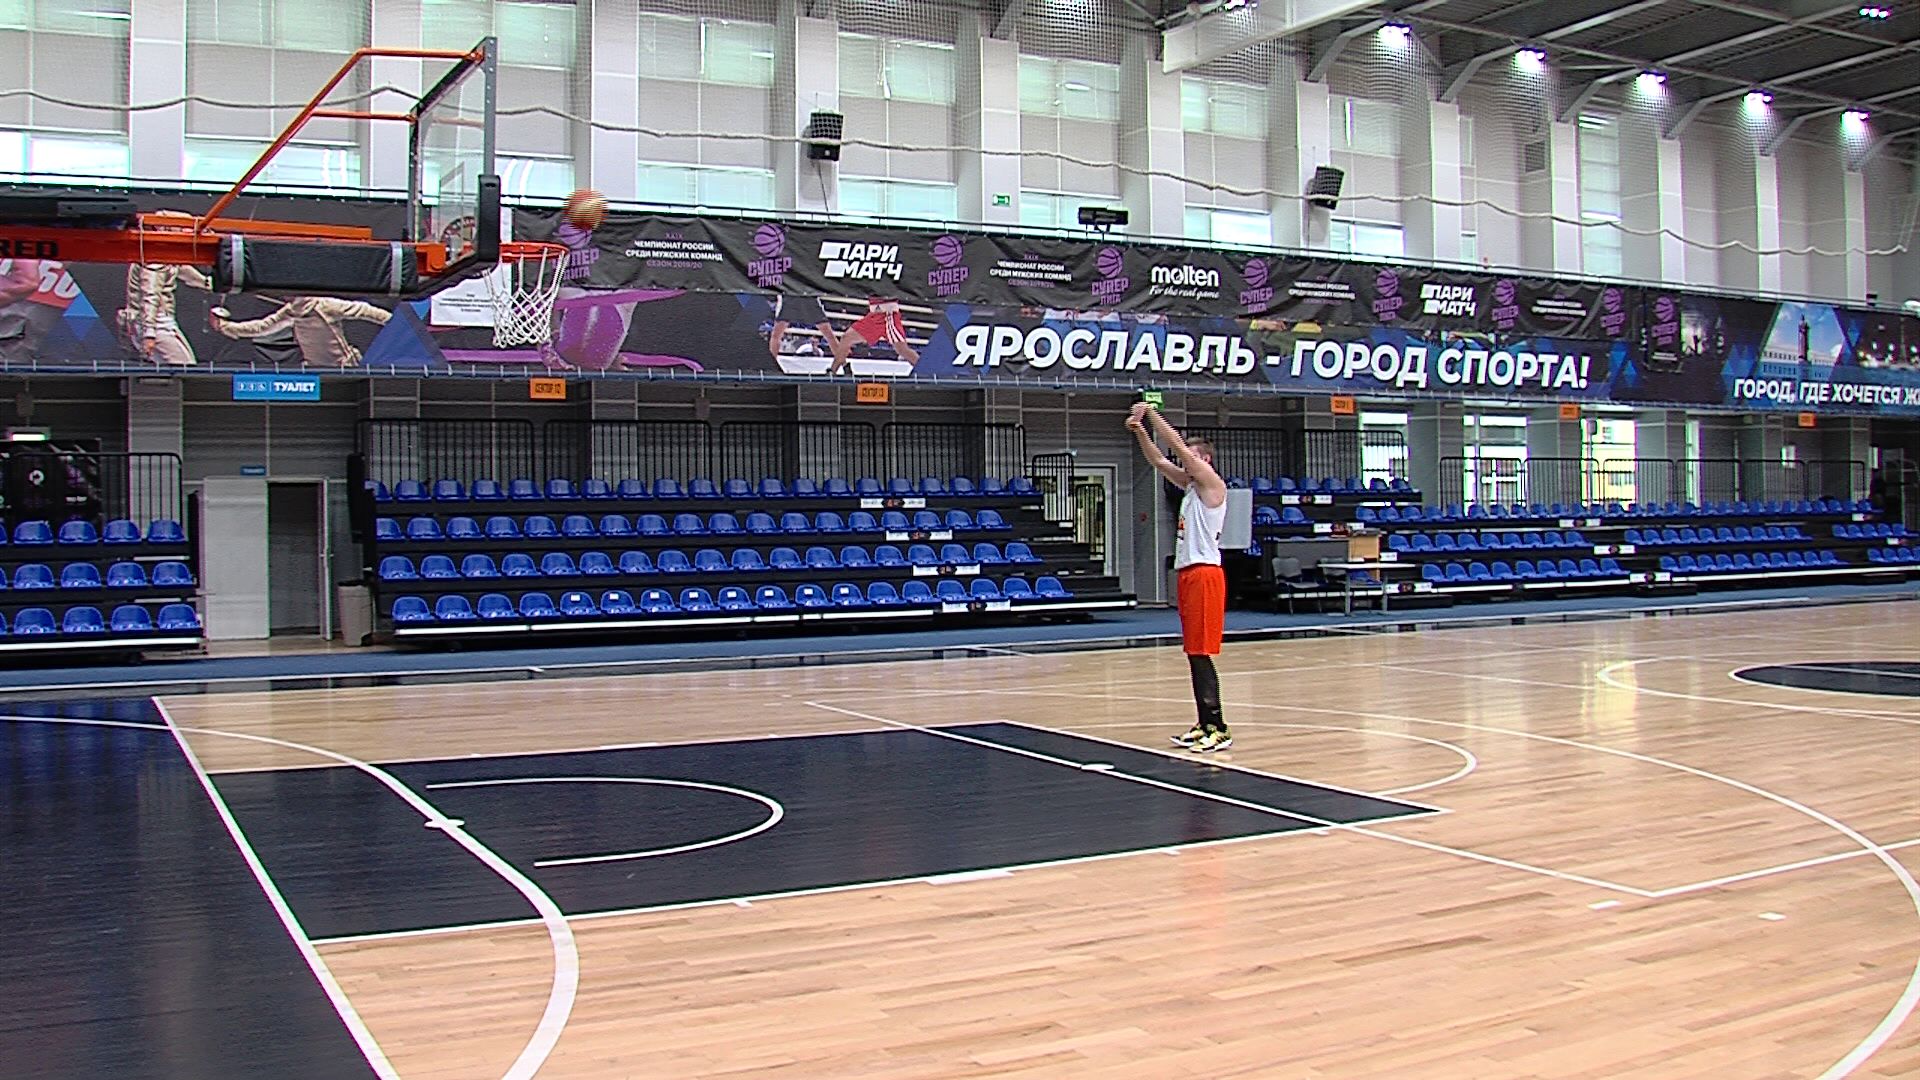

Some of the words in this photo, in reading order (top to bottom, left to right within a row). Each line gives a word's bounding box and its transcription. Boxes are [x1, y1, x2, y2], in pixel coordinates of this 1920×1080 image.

[634, 240, 681, 249] ЧЕМПИОНАТ
[682, 242, 714, 250] РОССИИ
[819, 241, 899, 263] ПАРИ
[625, 249, 651, 258] СРЕДИ
[652, 250, 690, 259] МУЖСКИХ
[690, 252, 723, 262] КОМАНД
[747, 256, 792, 278] СУПЕР
[823, 260, 904, 281] МАТЧ
[927, 266, 969, 286] СУПЕР
[1151, 264, 1220, 288] molten
[757, 274, 784, 288] ЛИГА
[1091, 277, 1129, 296] СУПЕР
[1148, 284, 1164, 296] For
[1164, 285, 1179, 296] the
[1179, 287, 1196, 298] real
[1196, 290, 1220, 301] game
[1420, 283, 1475, 302] ПАРИ
[1423, 299, 1477, 317] МАТЧ
[951, 325, 1255, 375] ЯРОСЛАВЛЬ
[1290, 340, 1429, 389] ГОРОД
[1436, 348, 1591, 389] СПОРТА!
[273, 381, 316, 393] ТУАЛЕТ
[1734, 378, 1795, 403] ГОРОД,
[1799, 381, 1830, 406] ГДЕ
[1830, 383, 1901, 406] ХОЧЕТСЯ
